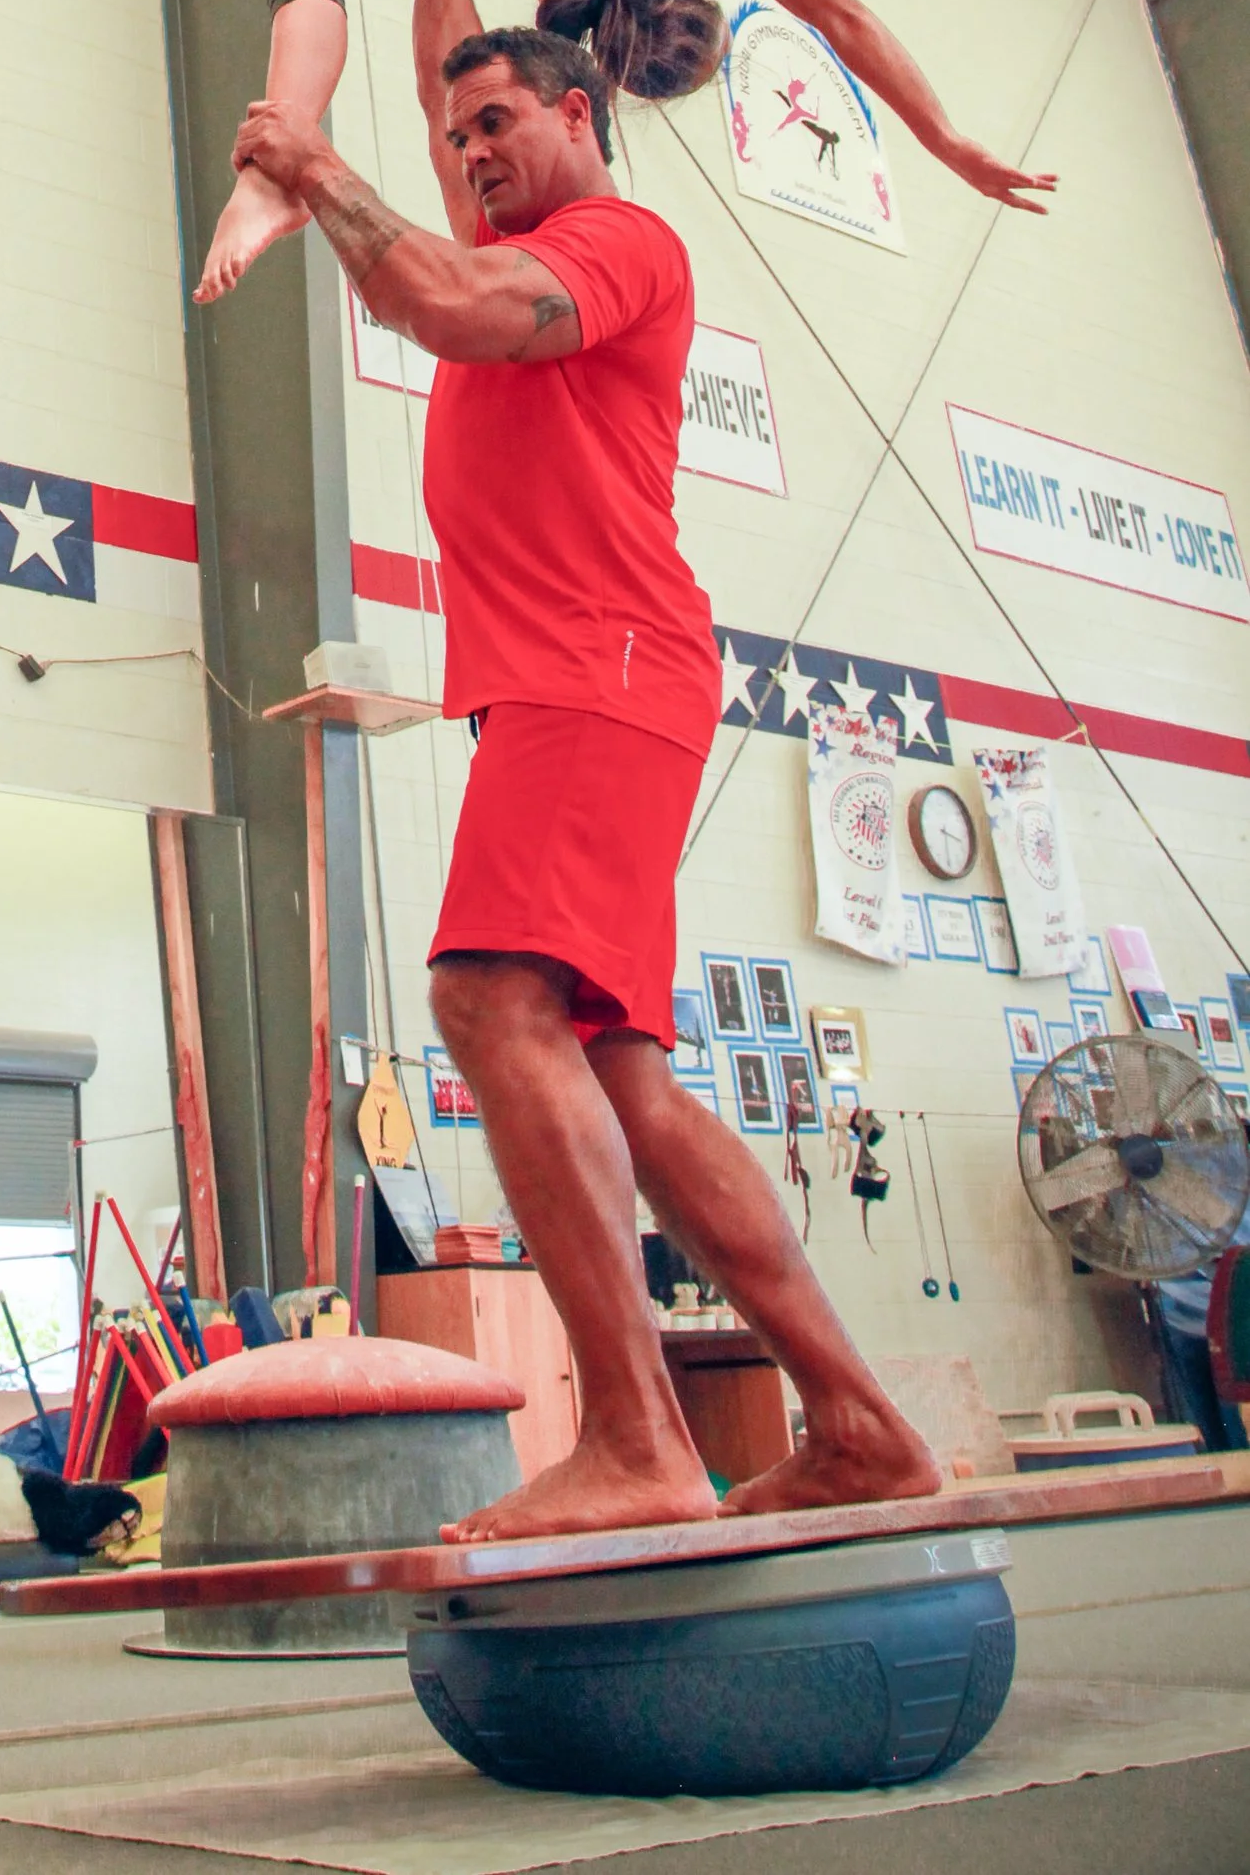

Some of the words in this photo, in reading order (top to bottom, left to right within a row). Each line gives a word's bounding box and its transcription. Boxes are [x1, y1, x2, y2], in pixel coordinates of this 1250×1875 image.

[747, 25, 818, 60] GYMNASTICS
[820, 61, 868, 143] ACADEMY
[960, 450, 1043, 524] LEARN
[1040, 475, 1066, 530] IT
[1078, 487, 1133, 550] LIVE
[1128, 502, 1152, 556] IT
[1164, 513, 1223, 577] LOVE
[1218, 529, 1243, 581] IT
[844, 886, 877, 907] Level
